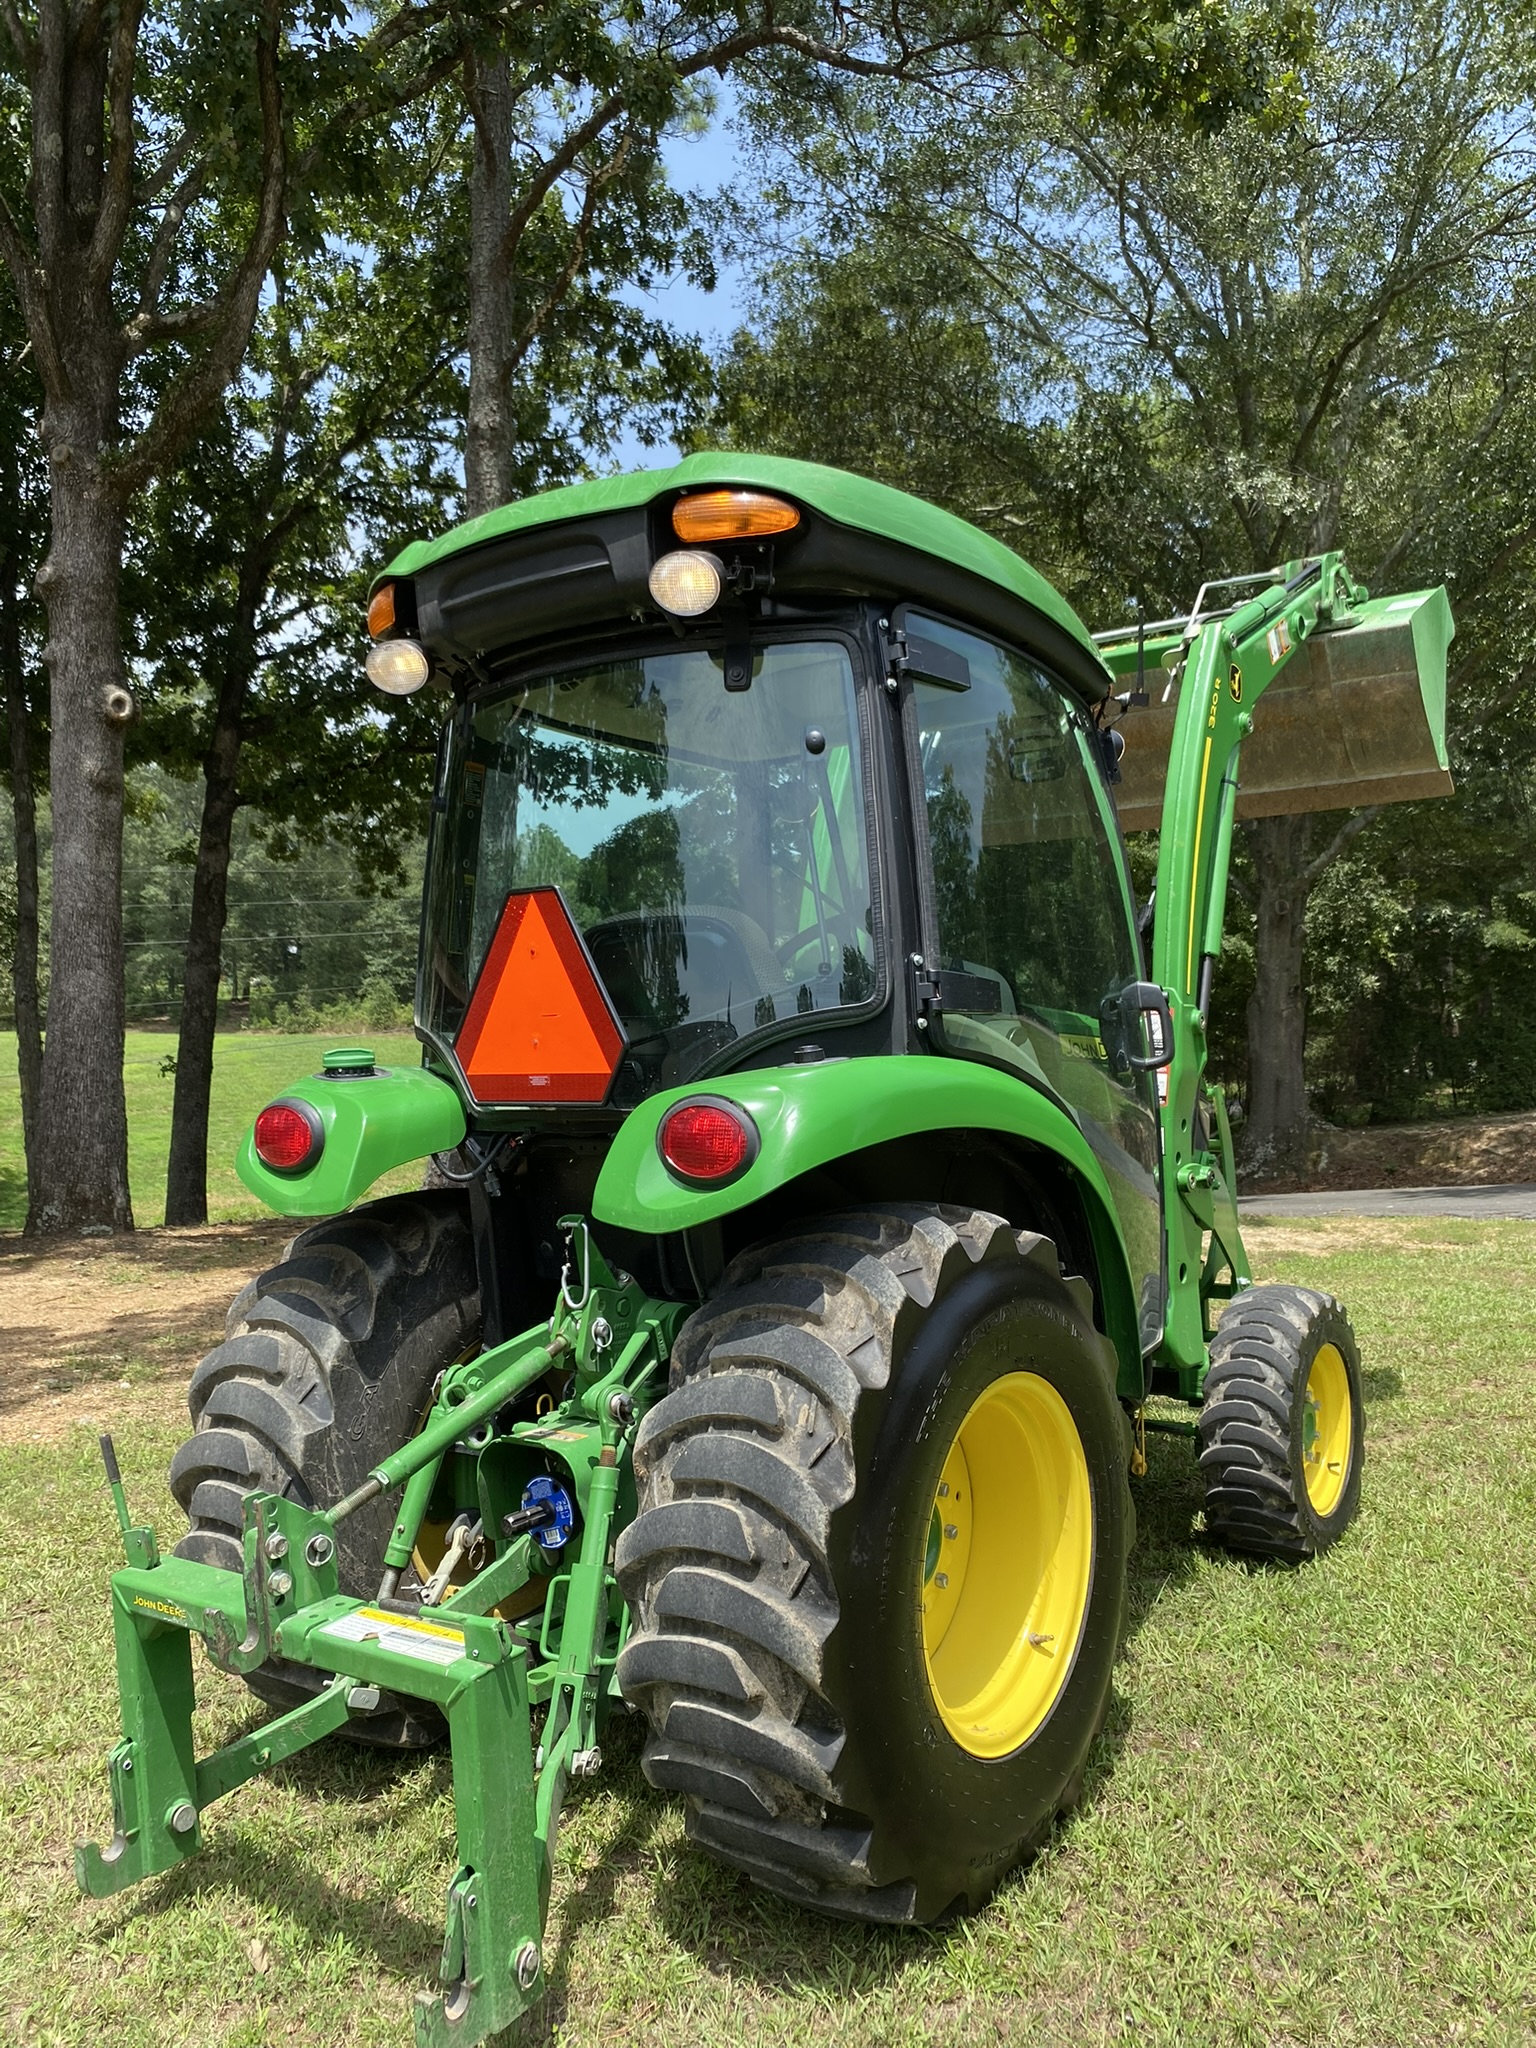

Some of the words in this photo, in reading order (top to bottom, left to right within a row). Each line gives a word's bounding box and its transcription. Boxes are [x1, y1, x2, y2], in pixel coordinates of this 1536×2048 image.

[1066, 1038, 1099, 1059] JOHN
[133, 1594, 157, 1610] JOHN
[157, 1601, 187, 1619] DEERE
